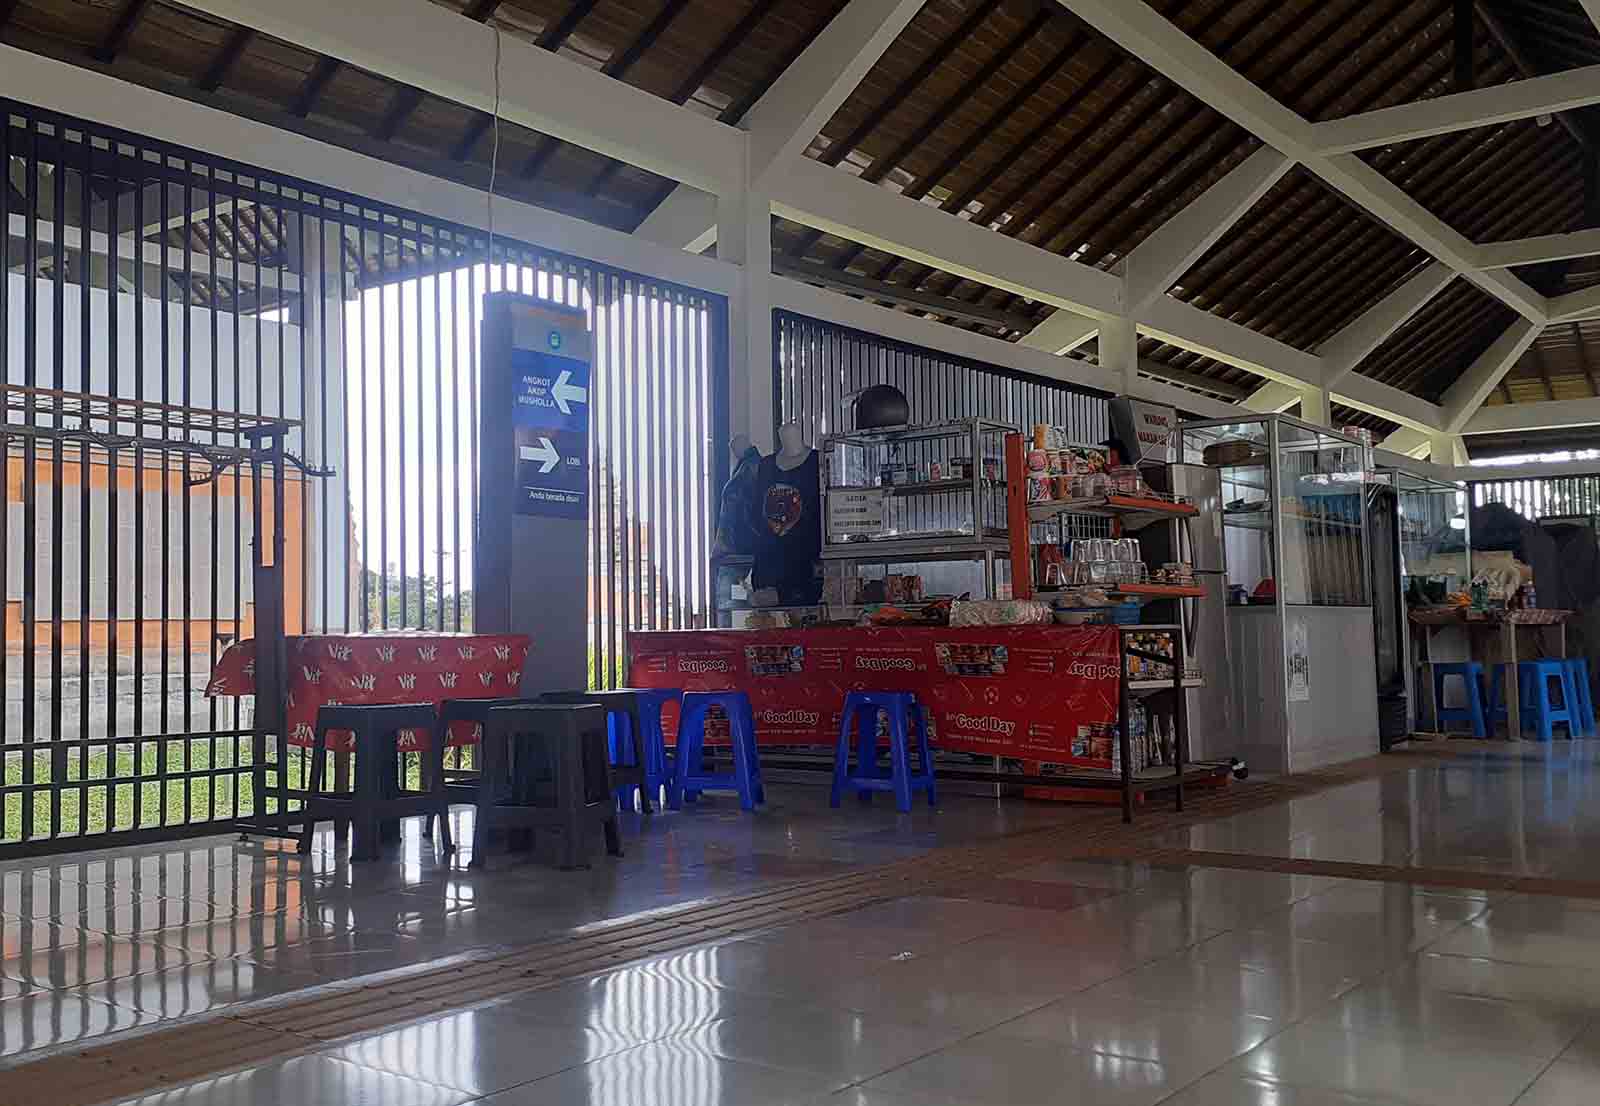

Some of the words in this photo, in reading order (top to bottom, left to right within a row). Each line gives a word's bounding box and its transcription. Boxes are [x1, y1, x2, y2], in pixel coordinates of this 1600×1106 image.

[522, 375, 551, 386] ANGKOT
[518, 395, 555, 409] MUSHOLLA
[529, 490, 545, 500] Anda
[328, 643, 353, 661] Vit
[376, 644, 397, 662] Vit
[417, 644, 439, 661] Vit
[457, 645, 476, 661] Vit
[494, 645, 512, 661] Vit
[303, 664, 323, 683] Vit
[1066, 660, 1097, 680] Day
[353, 673, 377, 691] Vit
[398, 672, 417, 690] Vit
[438, 672, 459, 689] Vit
[478, 671, 494, 687] Vit
[764, 710, 795, 724] Good
[795, 711, 819, 726] Day
[955, 713, 988, 731] Good
[989, 716, 1016, 736] Day
